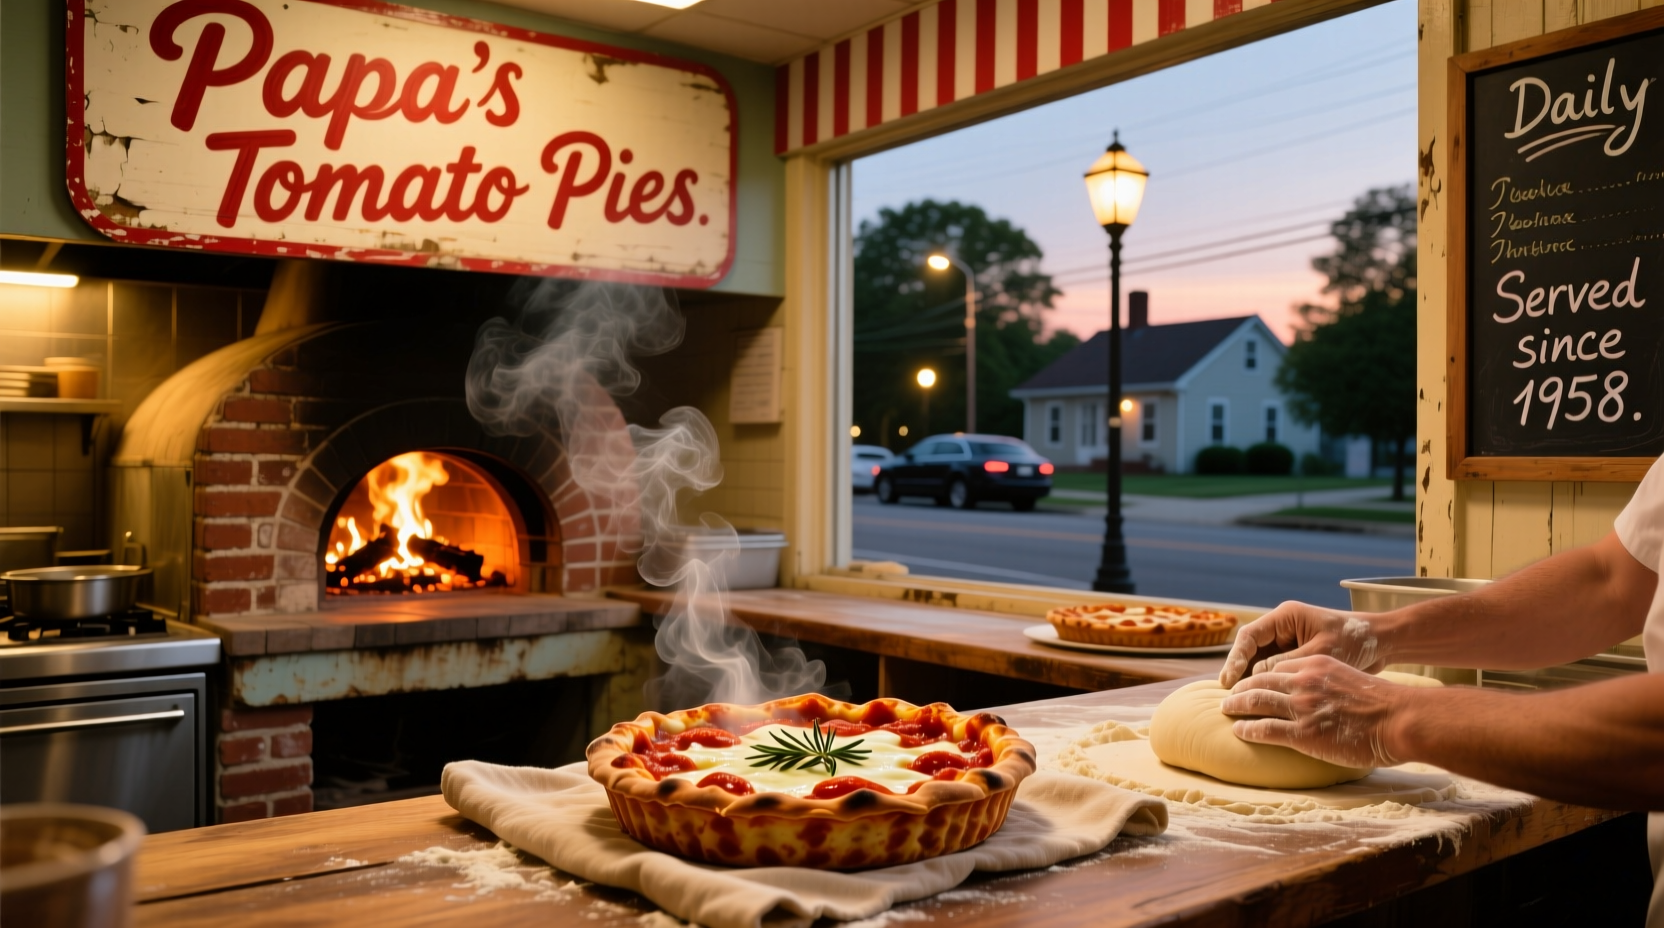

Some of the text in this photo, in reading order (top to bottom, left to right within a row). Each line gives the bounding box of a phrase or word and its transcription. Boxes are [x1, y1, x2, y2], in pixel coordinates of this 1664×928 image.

[149, 0, 523, 150] Papa's
[1504, 57, 1650, 157] Daily
[205, 129, 711, 229] Tomato Pies.
[1493, 256, 1646, 323] Served
[1512, 328, 1626, 369] since
[1513, 370, 1642, 430] 1958.
